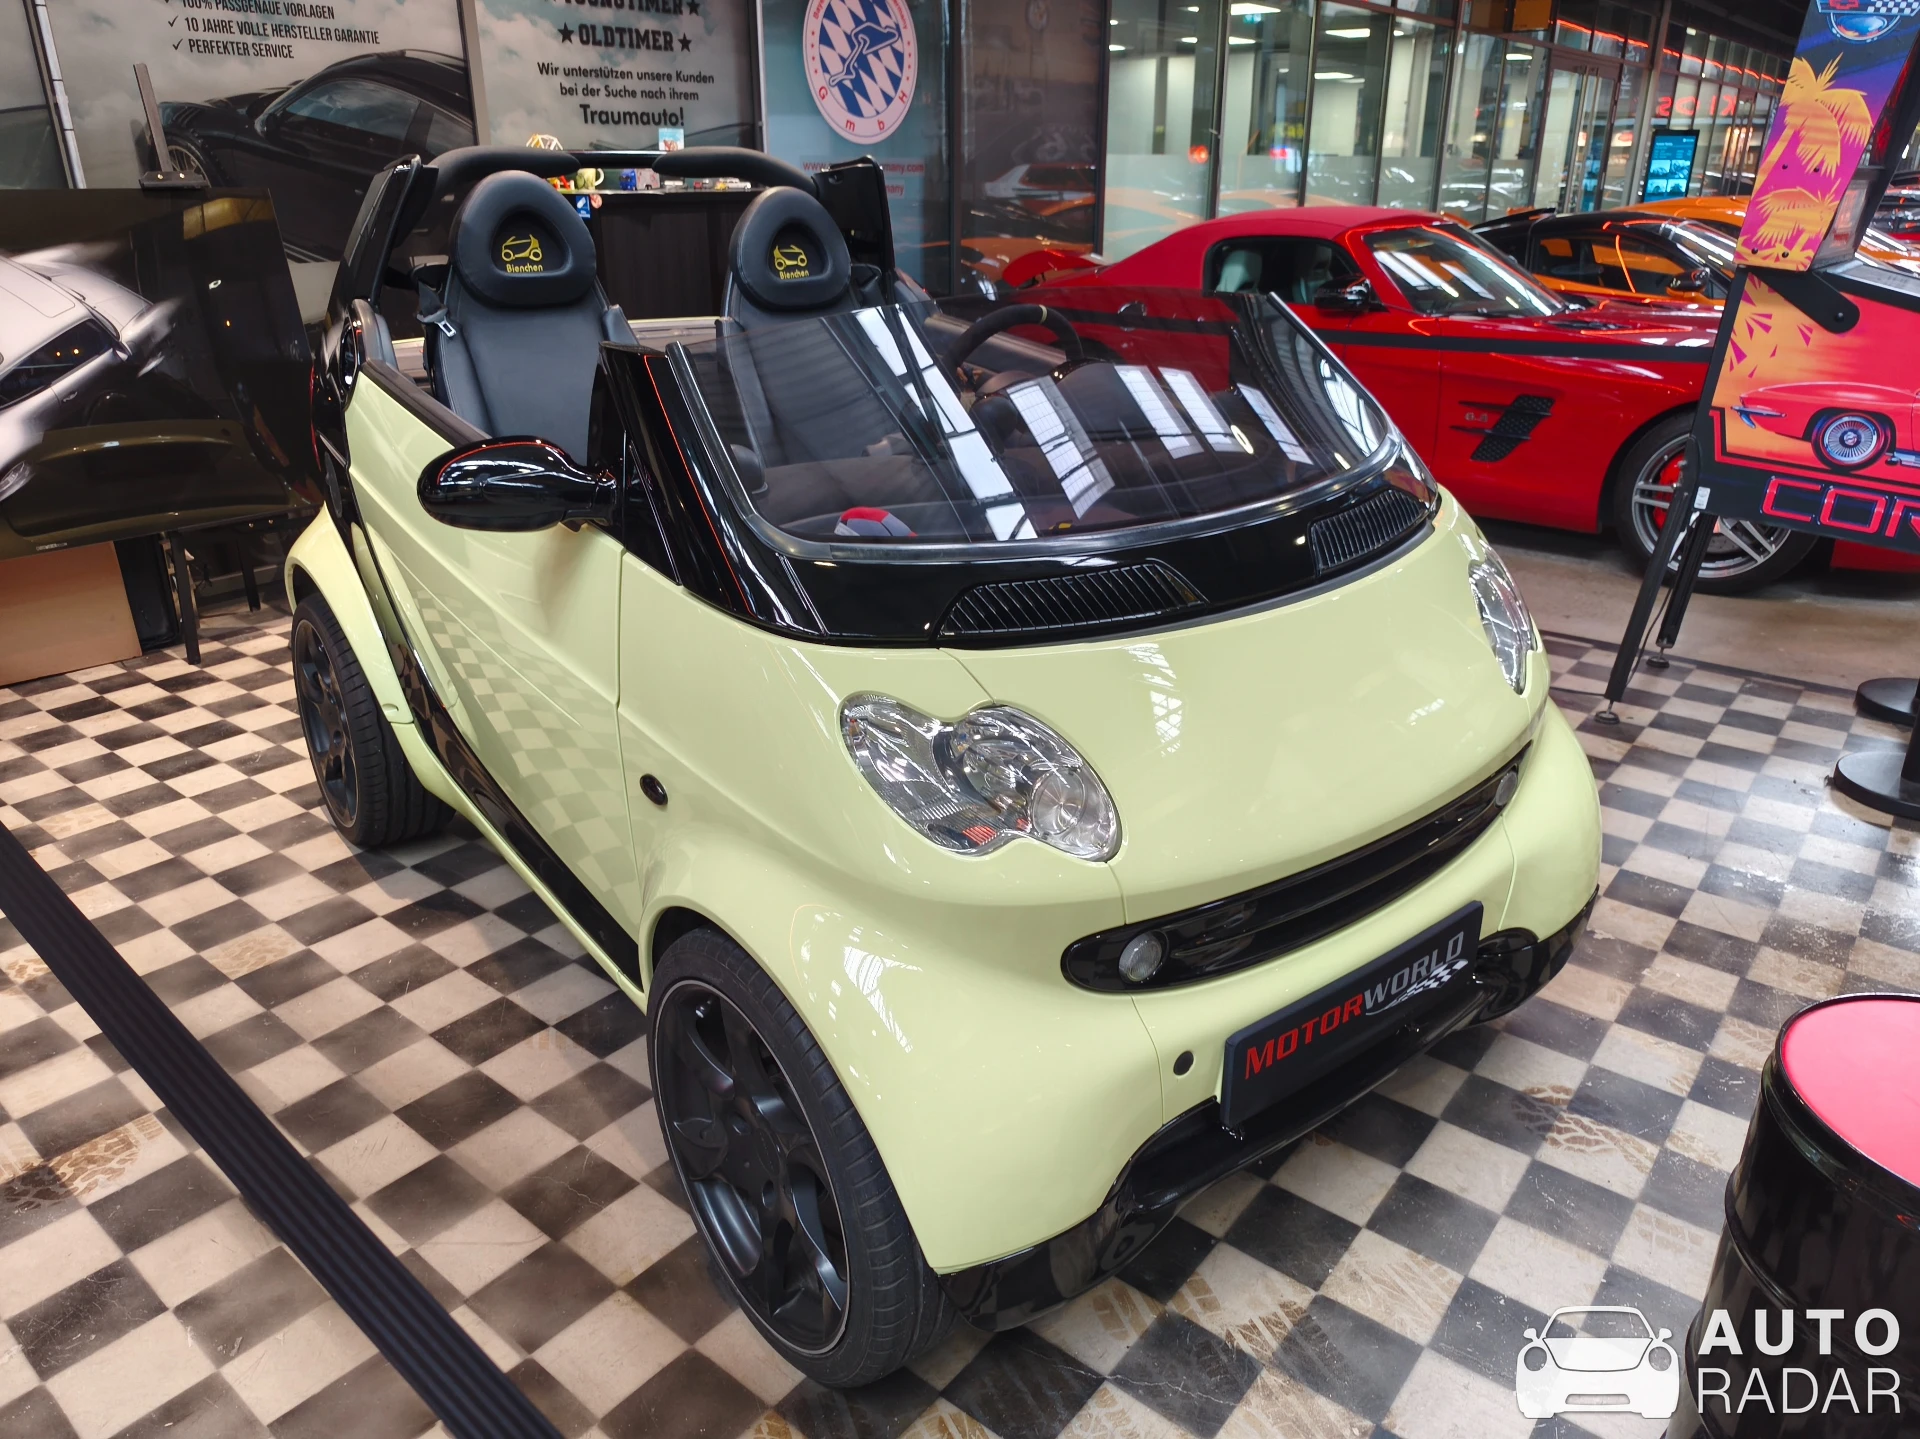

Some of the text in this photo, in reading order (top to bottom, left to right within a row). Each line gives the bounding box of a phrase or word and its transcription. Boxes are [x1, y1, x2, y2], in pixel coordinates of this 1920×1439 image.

[215, 0, 282, 15] PASSGENAUE
[284, 2, 335, 20] VORLAGEN
[185, 17, 380, 45] 10 JAHRE VOLLE HERSTELLER GARANTIE
[578, 23, 674, 52] OLDTIMER
[188, 38, 295, 59] PERFEKTER SERVICE
[537, 61, 715, 85] Wir unterstützen unsere Kunden
[560, 82, 699, 101] bei der Suche nach ihrem
[579, 103, 685, 127] Traumauto!
[506, 262, 544, 274] Bienchen
[779, 268, 810, 280] Bienchen
[1244, 930, 1465, 1081] MOTORWORLD
